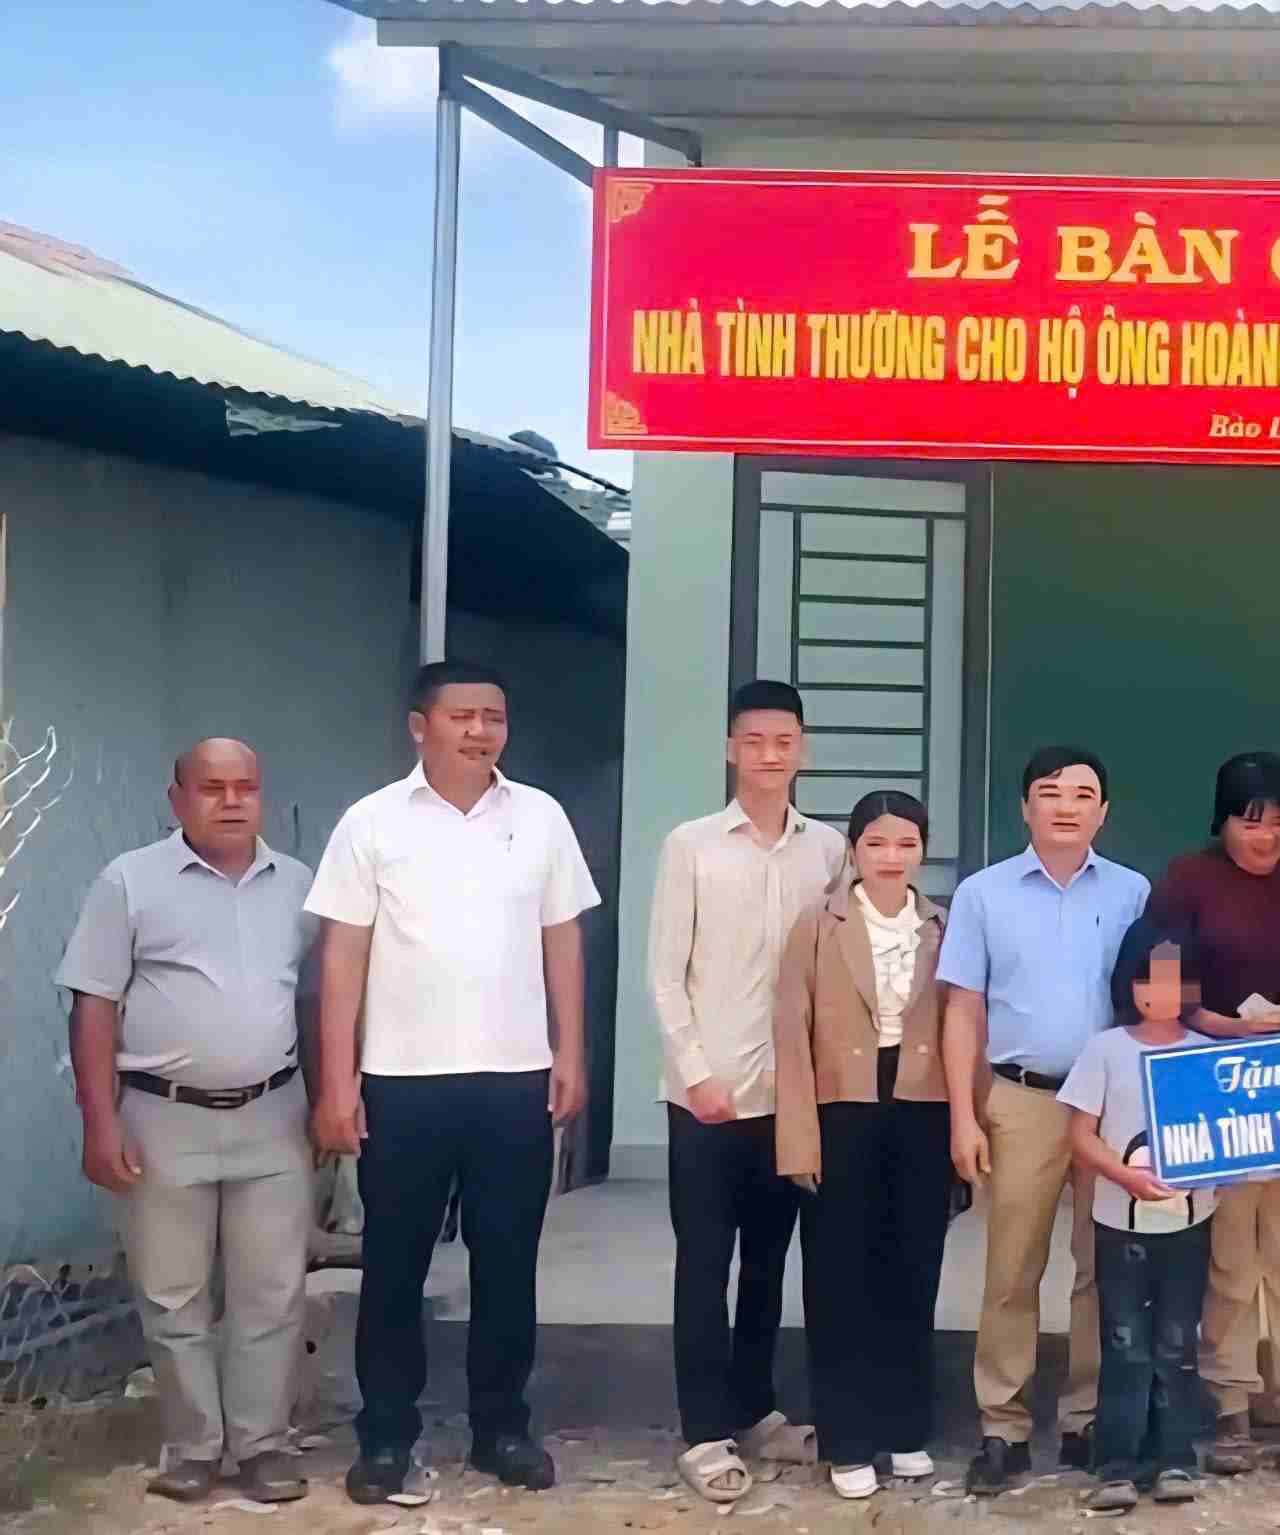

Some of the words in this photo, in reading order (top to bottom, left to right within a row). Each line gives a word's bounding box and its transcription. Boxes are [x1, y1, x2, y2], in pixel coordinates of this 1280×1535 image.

[908, 194, 1020, 281] LỄ
[1055, 211, 1239, 284] BÀN
[632, 297, 704, 375] NHÀ
[716, 297, 797, 377] TÌNH
[807, 309, 946, 381] THƯƠNG
[957, 316, 1027, 382] CHO
[1038, 304, 1085, 399] HỘ
[1097, 304, 1171, 386] ÔNG
[1162, 1113, 1215, 1166] NHÀ
[1217, 1107, 1274, 1158] TÌNH
